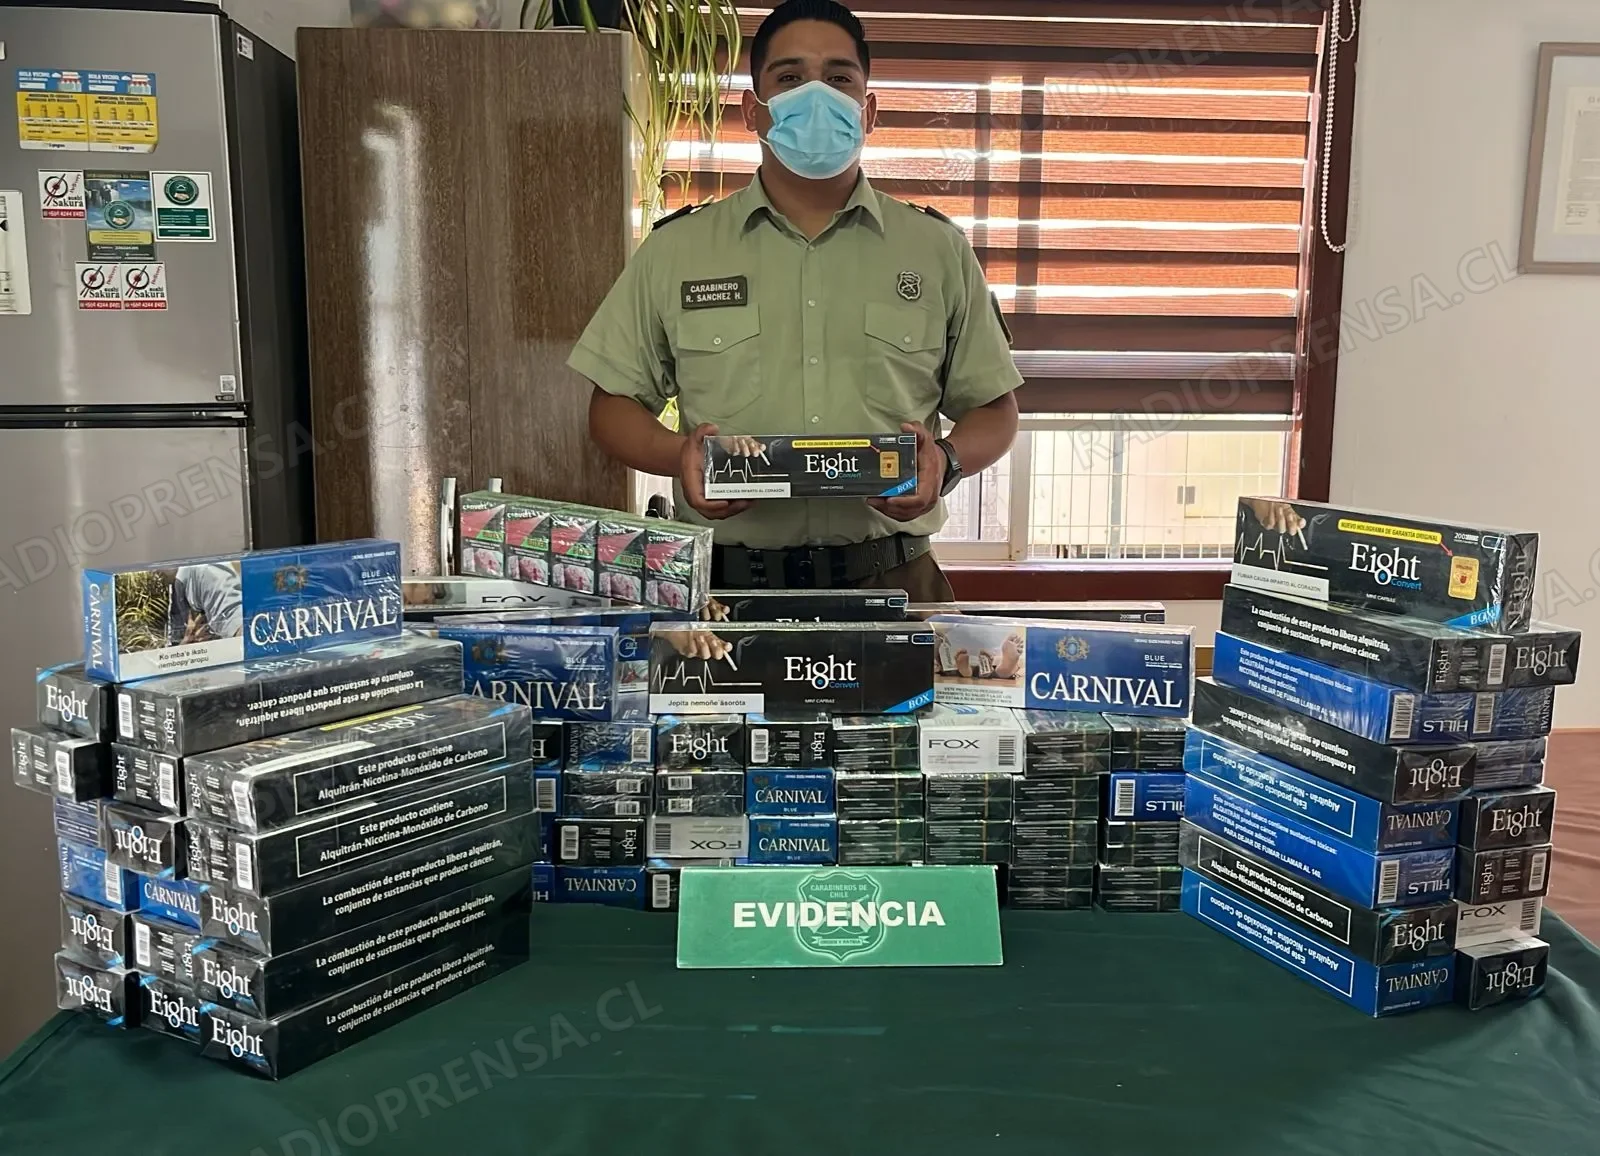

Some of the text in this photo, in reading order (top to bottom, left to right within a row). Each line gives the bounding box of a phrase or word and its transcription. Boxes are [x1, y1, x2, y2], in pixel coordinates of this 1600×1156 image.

[89, 290, 120, 298] Sakura
[135, 290, 164, 298] Sakura
[690, 283, 738, 293] CARABINERO
[697, 292, 730, 302] SANCHEZ
[805, 452, 858, 479] Eight
[897, 480, 913, 493] BOX
[362, 569, 381, 579] BLUE
[1349, 542, 1421, 585] Eight
[89, 583, 103, 670] CARNIVAL
[250, 595, 398, 647] CARNIVAL
[1251, 605, 1391, 652] La combustión de este producto libera alquitrán,
[1257, 620, 1380, 661] conjunto de sustancias que produce cáncer.
[784, 655, 856, 689] Eight
[1144, 654, 1165, 662] BLUE
[1436, 649, 1450, 683] Eight
[1516, 644, 1567, 676] Eight
[46, 684, 88, 722] Eight
[471, 679, 606, 711] ARNIVAL
[907, 693, 931, 710] BOX
[1030, 672, 1182, 709] CARNIVAL
[165, 707, 175, 745] Eight
[355, 712, 436, 735] Eight
[1423, 719, 1469, 733] HILLS
[18, 742, 28, 776] Eight
[358, 745, 453, 775] Este producto contiene
[569, 727, 580, 764] CARNIVAL
[671, 732, 728, 760] Eight
[811, 731, 825, 761] Eight
[928, 739, 980, 749] FOX
[116, 755, 127, 791] Eight
[318, 748, 488, 800] Alquitrán-Nicotina-Monóxido de Carbono
[1410, 758, 1463, 779] Eight
[189, 772, 200, 809] Eight
[755, 790, 826, 803] CARNIVAL
[1387, 810, 1452, 830] CARNIVAL
[1490, 804, 1543, 838] Eight
[115, 825, 163, 865] Eight
[621, 829, 637, 857] Eight
[690, 840, 742, 850] FOX
[759, 838, 830, 852] CARNIVAL
[1224, 827, 1237, 838] PARA
[1238, 833, 1254, 846] DEJAR
[1254, 841, 1262, 850] DE
[1262, 845, 1280, 859] FUMAR
[1280, 853, 1303, 869] LLAMAR
[1303, 864, 1311, 874] AL
[322, 839, 503, 906] La combustión de este producto libera alquitrán,
[335, 854, 495, 915] conjunto de sustancias que produce cáncer.
[564, 878, 637, 892] CARNIVAL
[1236, 861, 1305, 901] Este producto contiene
[1408, 879, 1449, 894] HILLS
[1480, 862, 1493, 896] Eight
[144, 882, 200, 915] CARNIVAL
[1211, 860, 1333, 928] Alquitrán-Nicotina-Monóxido de Carbono
[210, 895, 259, 936] Eight
[733, 901, 946, 927] EVIDENCIA
[1459, 904, 1506, 921] FOX
[70, 914, 114, 952] Eight
[1394, 919, 1446, 952] Eight
[66, 975, 113, 1013] Eight
[203, 958, 252, 998] Eight
[1386, 967, 1449, 993] CARNIVAL
[1486, 961, 1536, 996] Eight
[150, 989, 200, 1028] Eight
[212, 1017, 263, 1058] Eight
